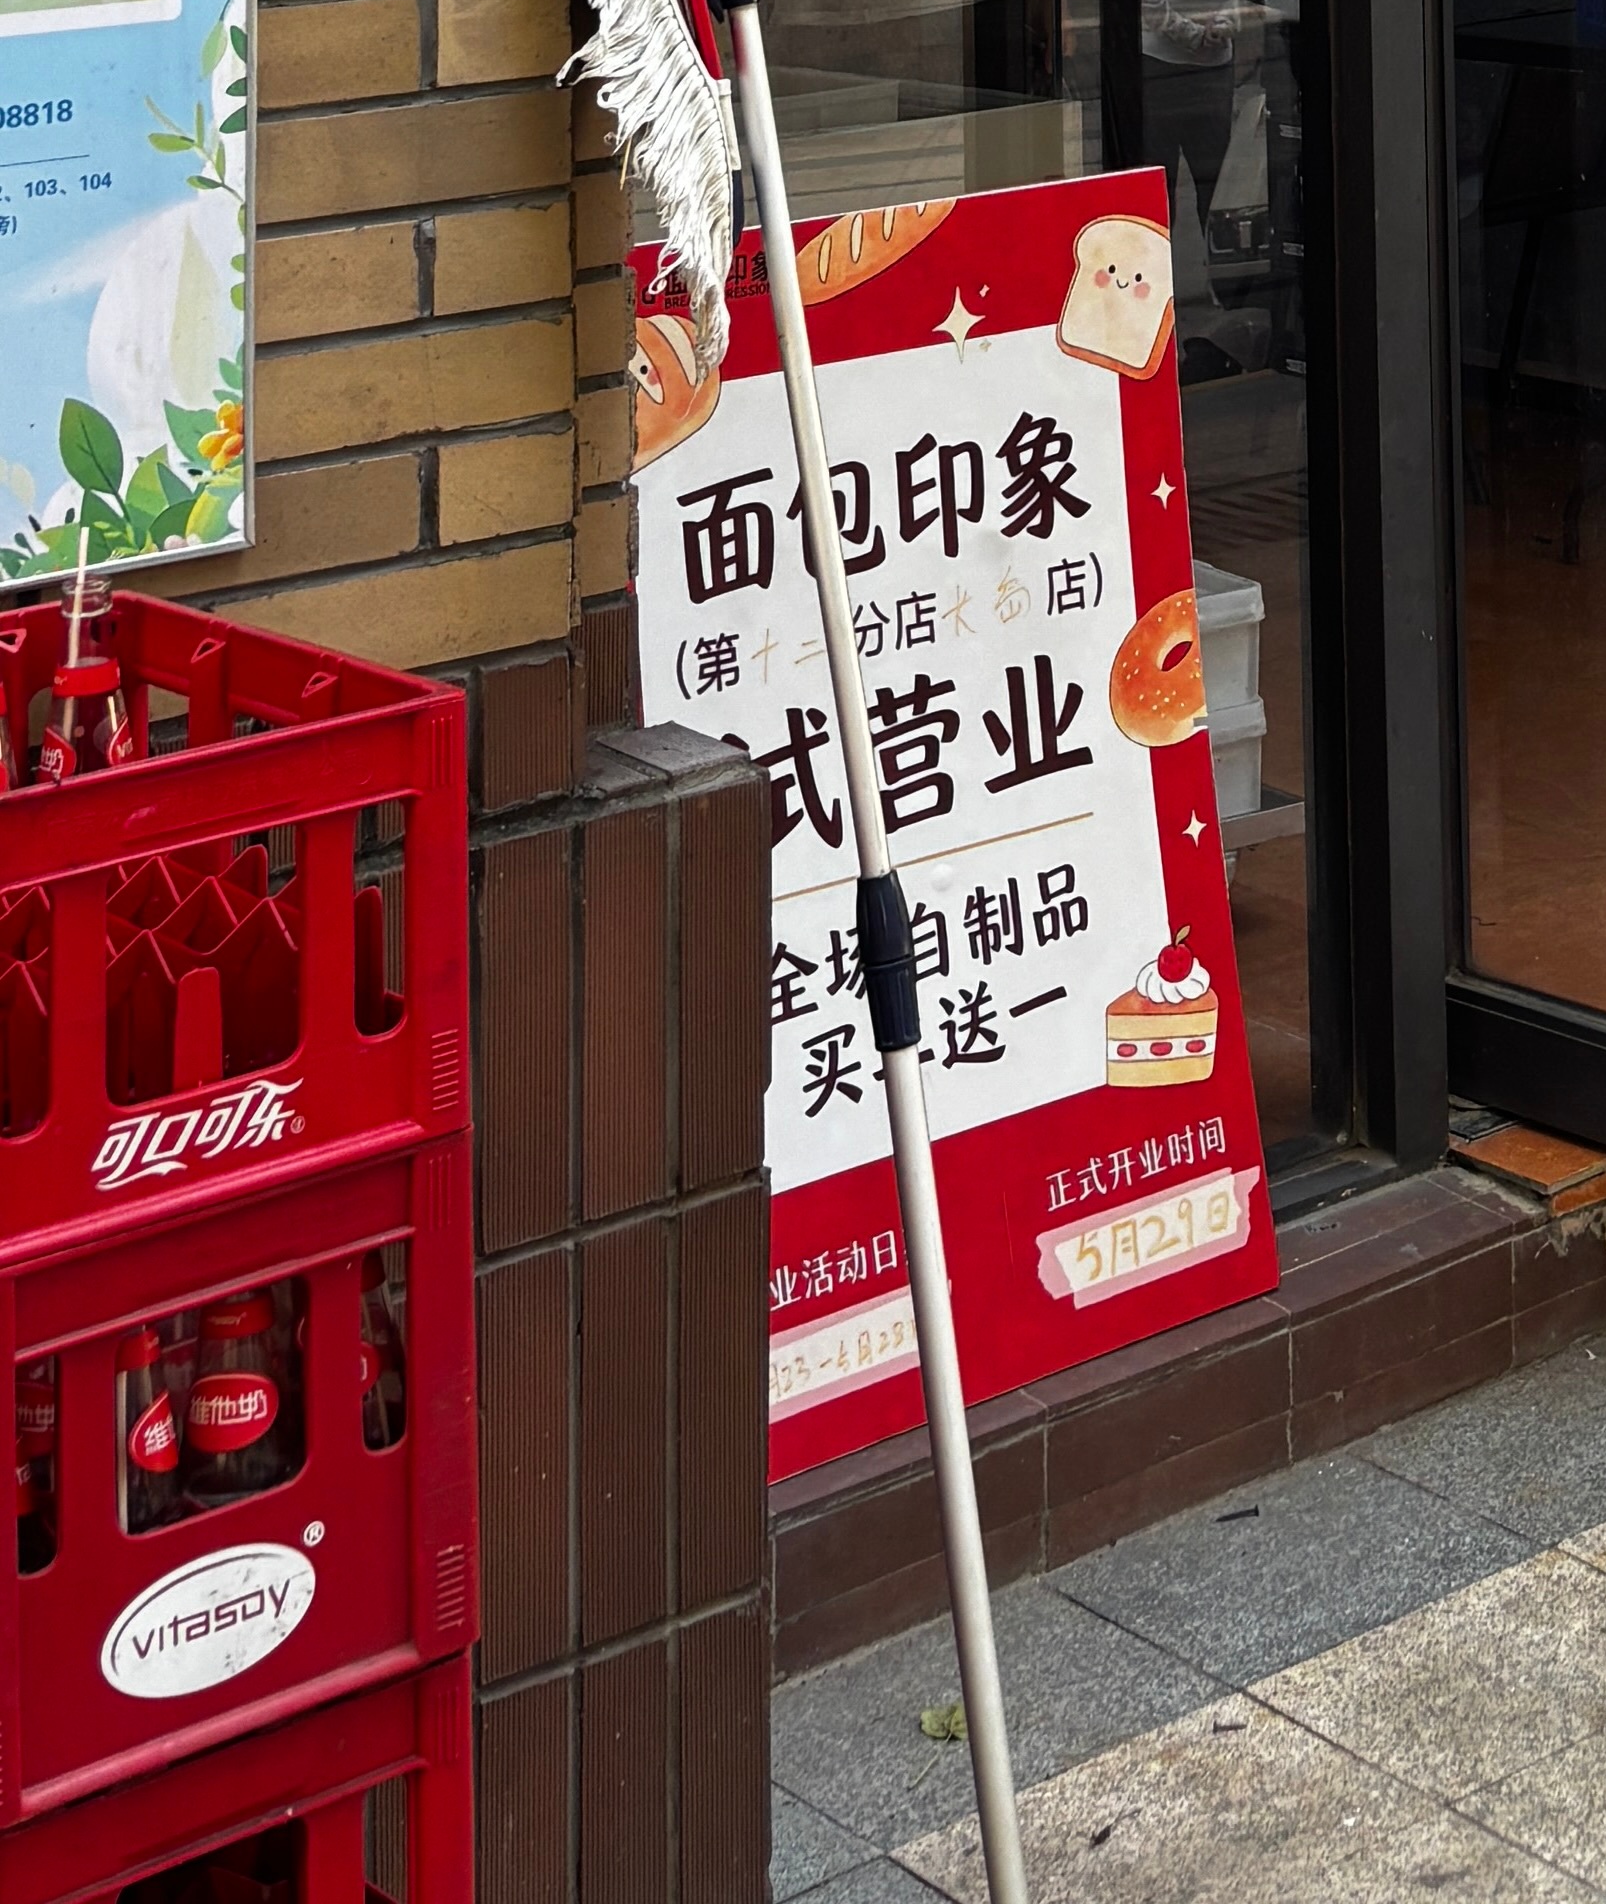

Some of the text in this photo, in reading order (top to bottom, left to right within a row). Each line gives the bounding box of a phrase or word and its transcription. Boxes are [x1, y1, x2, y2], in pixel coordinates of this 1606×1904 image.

[0, 98, 73, 130] 8818
[676, 411, 1092, 605] 面包印象
[91, 1077, 304, 1191] 可口可乐
[1045, 1116, 1226, 1212] 正式开业时间
[1075, 1190, 1230, 1282] 5月29日
[131, 1578, 291, 1661] vitasoy
